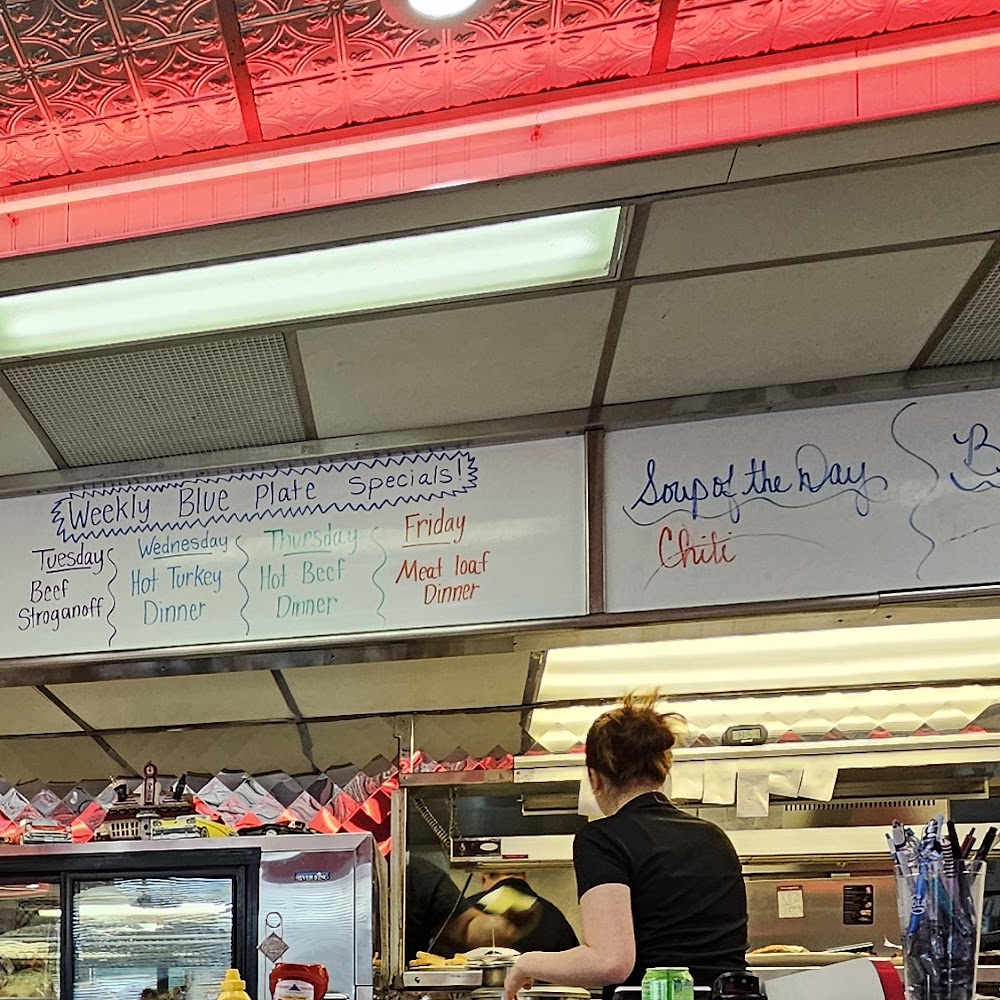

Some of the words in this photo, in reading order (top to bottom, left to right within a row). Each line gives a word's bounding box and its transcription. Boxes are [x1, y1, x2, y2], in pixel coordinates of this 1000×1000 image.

[68, 493, 151, 529] Weekly
[178, 486, 231, 518] Blue
[255, 479, 318, 510] Plate
[348, 457, 463, 500] Specials!
[631, 459, 708, 520] Soup
[712, 464, 741, 524] of
[742, 457, 792, 495] the
[796, 443, 888, 517] Day
[263, 522, 359, 556] Thursday
[405, 507, 466, 545] Friday
[32, 542, 104, 576] Tuesday
[138, 530, 229, 559] Wednesday
[658, 524, 738, 569] Chili
[131, 567, 159, 597] Hot
[167, 564, 222, 593] Turkey
[260, 561, 289, 592] Hot
[302, 558, 346, 585] Beef
[395, 556, 443, 584] Meat
[455, 550, 491, 576] loaf
[29, 579, 69, 604] Beef
[276, 593, 339, 619] Dinner
[424, 584, 480, 605] Dinner
[18, 597, 105, 632] Stroganoff
[143, 600, 206, 626] Dinner
